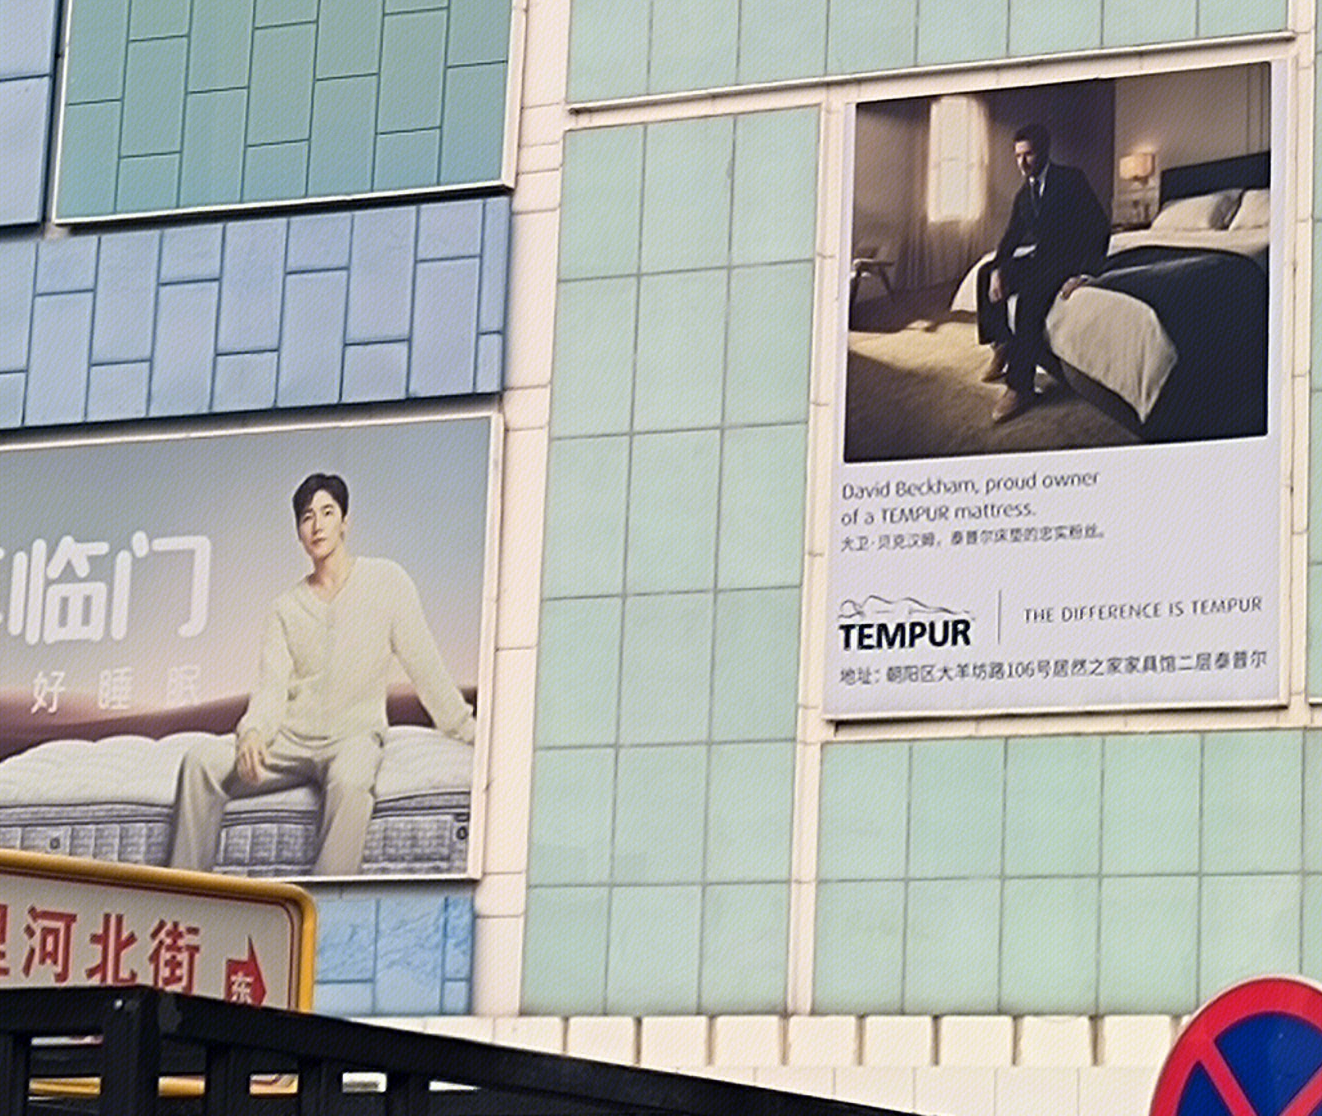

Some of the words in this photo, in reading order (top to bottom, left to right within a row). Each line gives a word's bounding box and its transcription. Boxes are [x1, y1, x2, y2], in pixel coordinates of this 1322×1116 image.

[842, 481, 890, 500] David
[895, 474, 979, 498] Beckham,
[985, 472, 1037, 495] proud
[1042, 471, 1100, 488] owner
[841, 508, 858, 526] of
[864, 511, 875, 525] a
[881, 504, 950, 524] TEMPUR
[954, 501, 1037, 521] mattress.
[1025, 606, 1055, 624] THE
[1061, 601, 1161, 622] DIFFERENCE
[1169, 601, 1184, 617] IS
[1192, 595, 1263, 615] TEMPUR
[838, 618, 972, 651] TEMPUR
